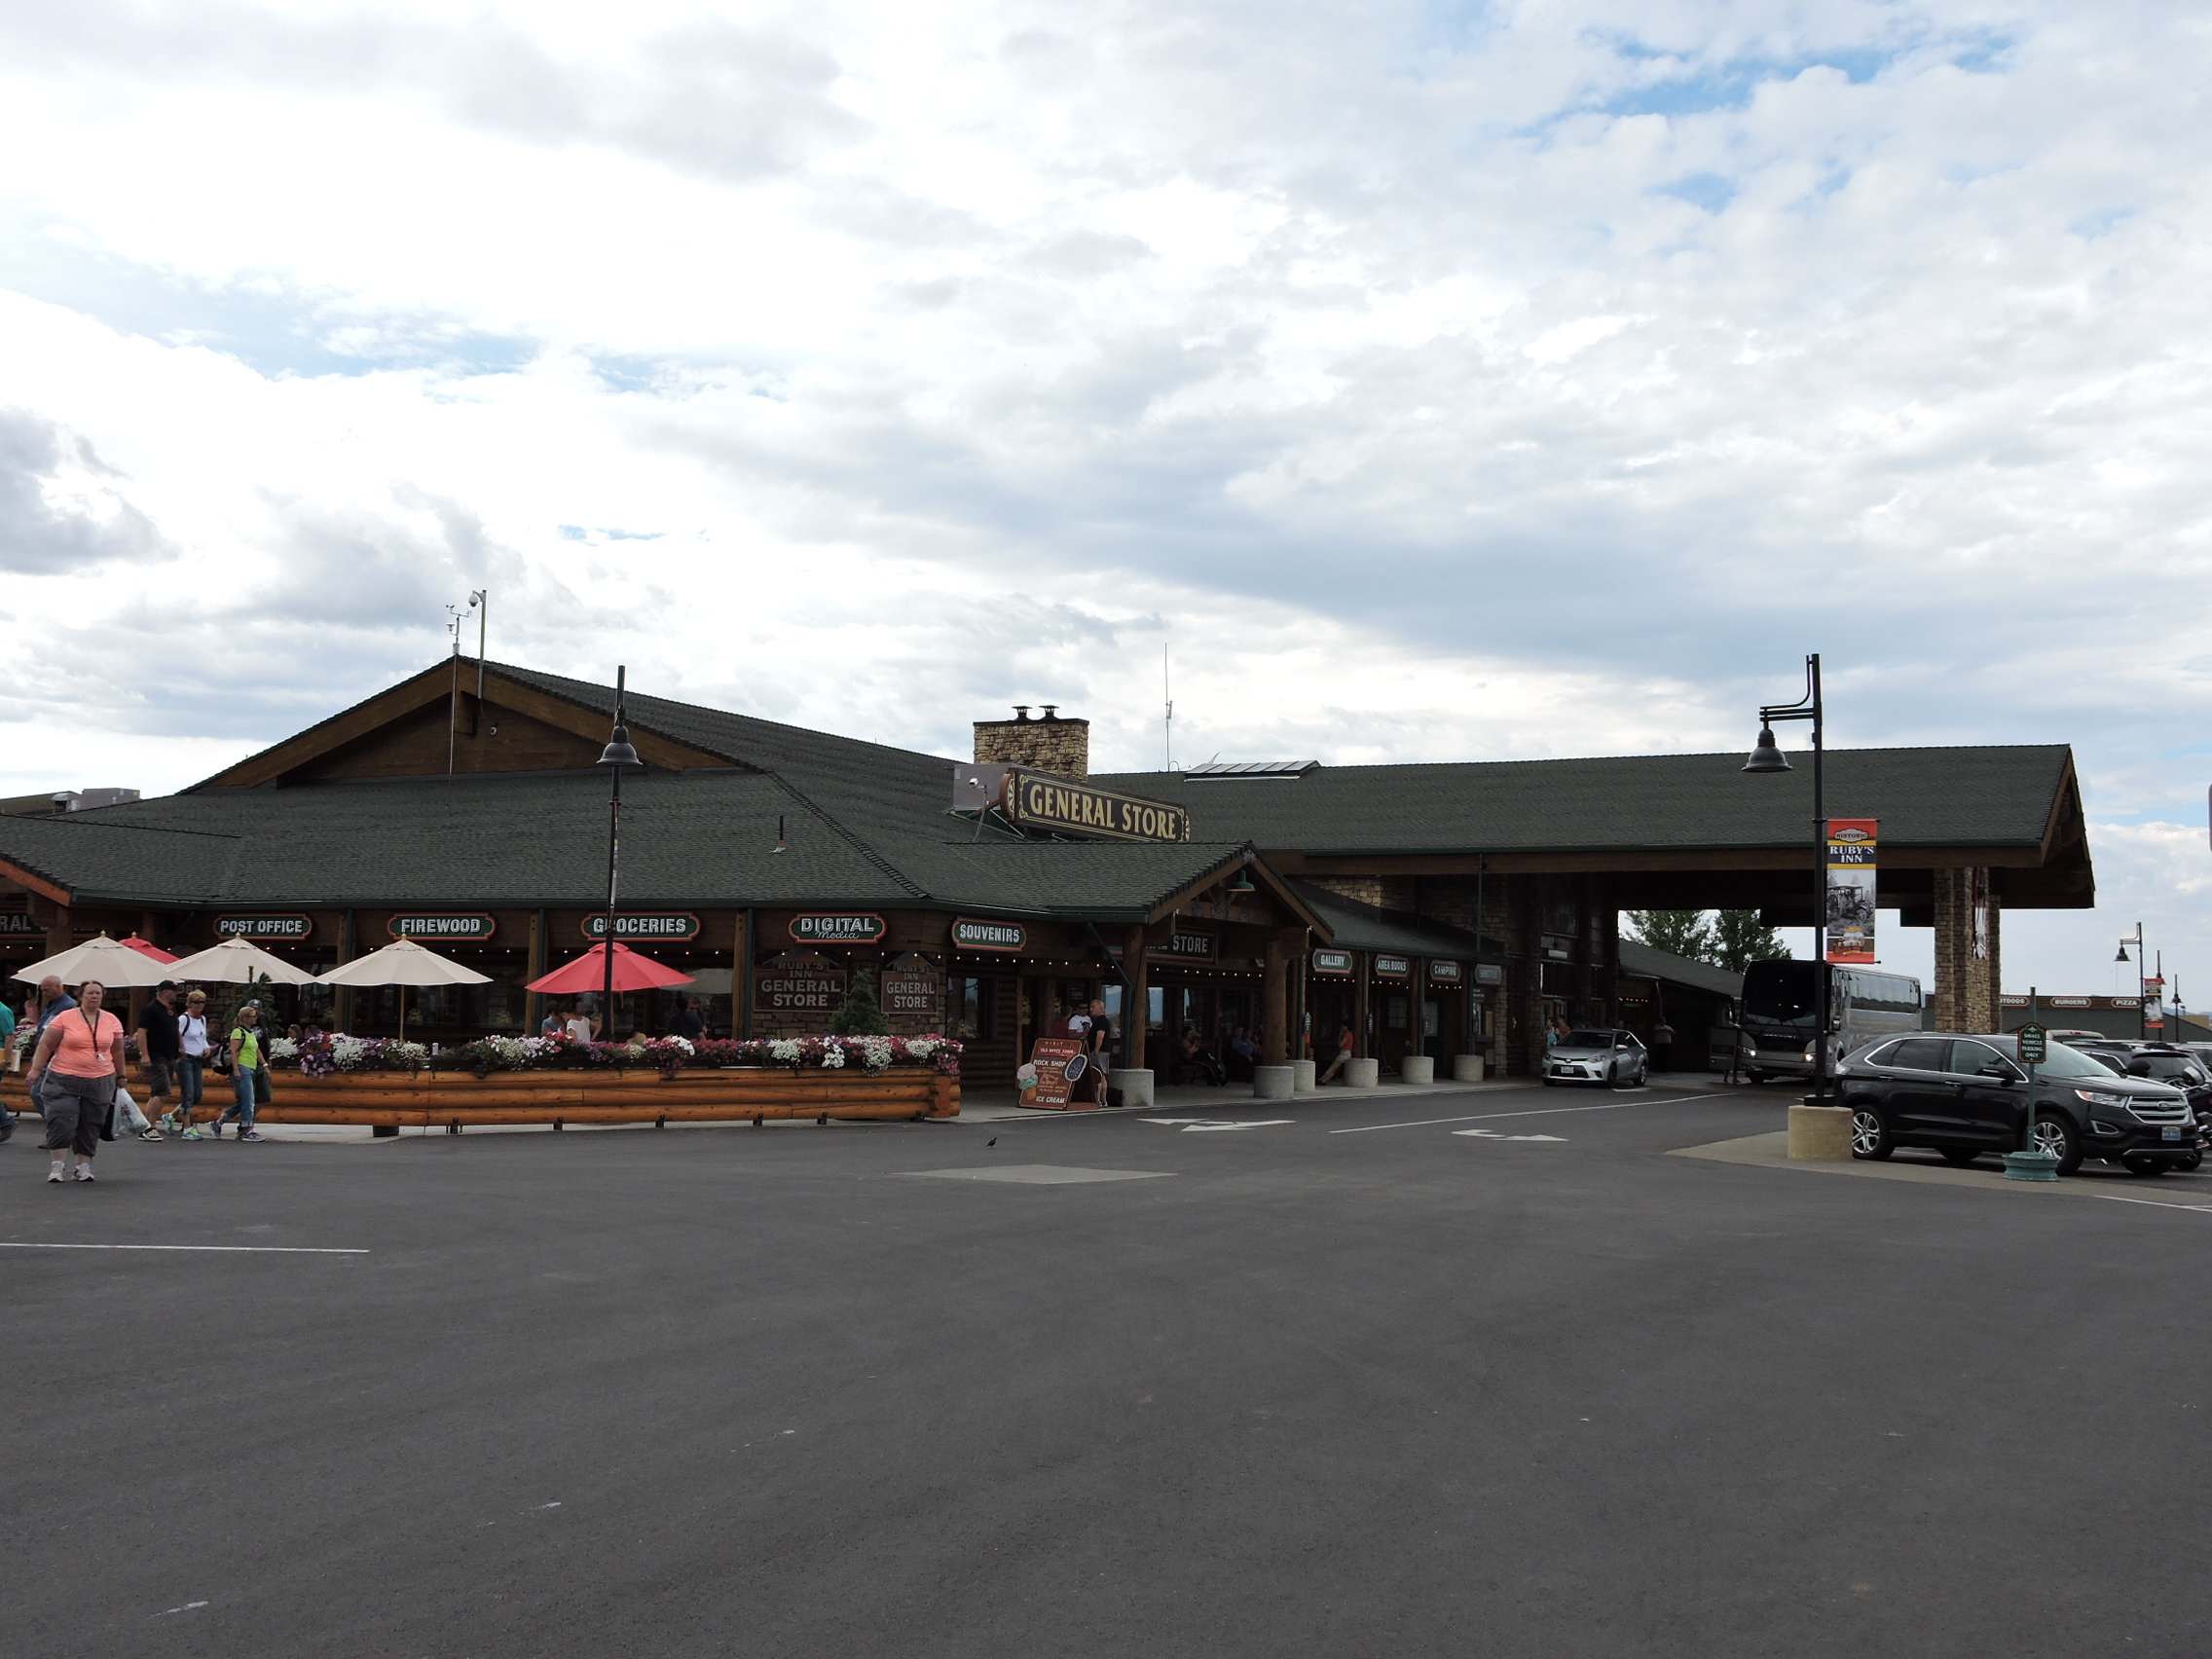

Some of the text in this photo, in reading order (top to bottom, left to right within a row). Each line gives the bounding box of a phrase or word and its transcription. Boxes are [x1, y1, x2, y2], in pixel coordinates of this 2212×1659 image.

[1030, 784, 1176, 840] GENERAL STORE
[1830, 845, 1874, 855] RUBY'S
[220, 920, 303, 934] POST OFFICE
[401, 918, 481, 933] FIREWOOD
[801, 917, 874, 932] DIGITAL
[960, 924, 1020, 943] SOUVENIRS
[1172, 935, 1208, 953] STORE
[1320, 954, 1346, 967] GALLERY
[761, 979, 841, 993] GENERAL
[886, 981, 936, 995] GENERAL
[772, 993, 829, 1007] STORE
[894, 995, 928, 1009] STORE
